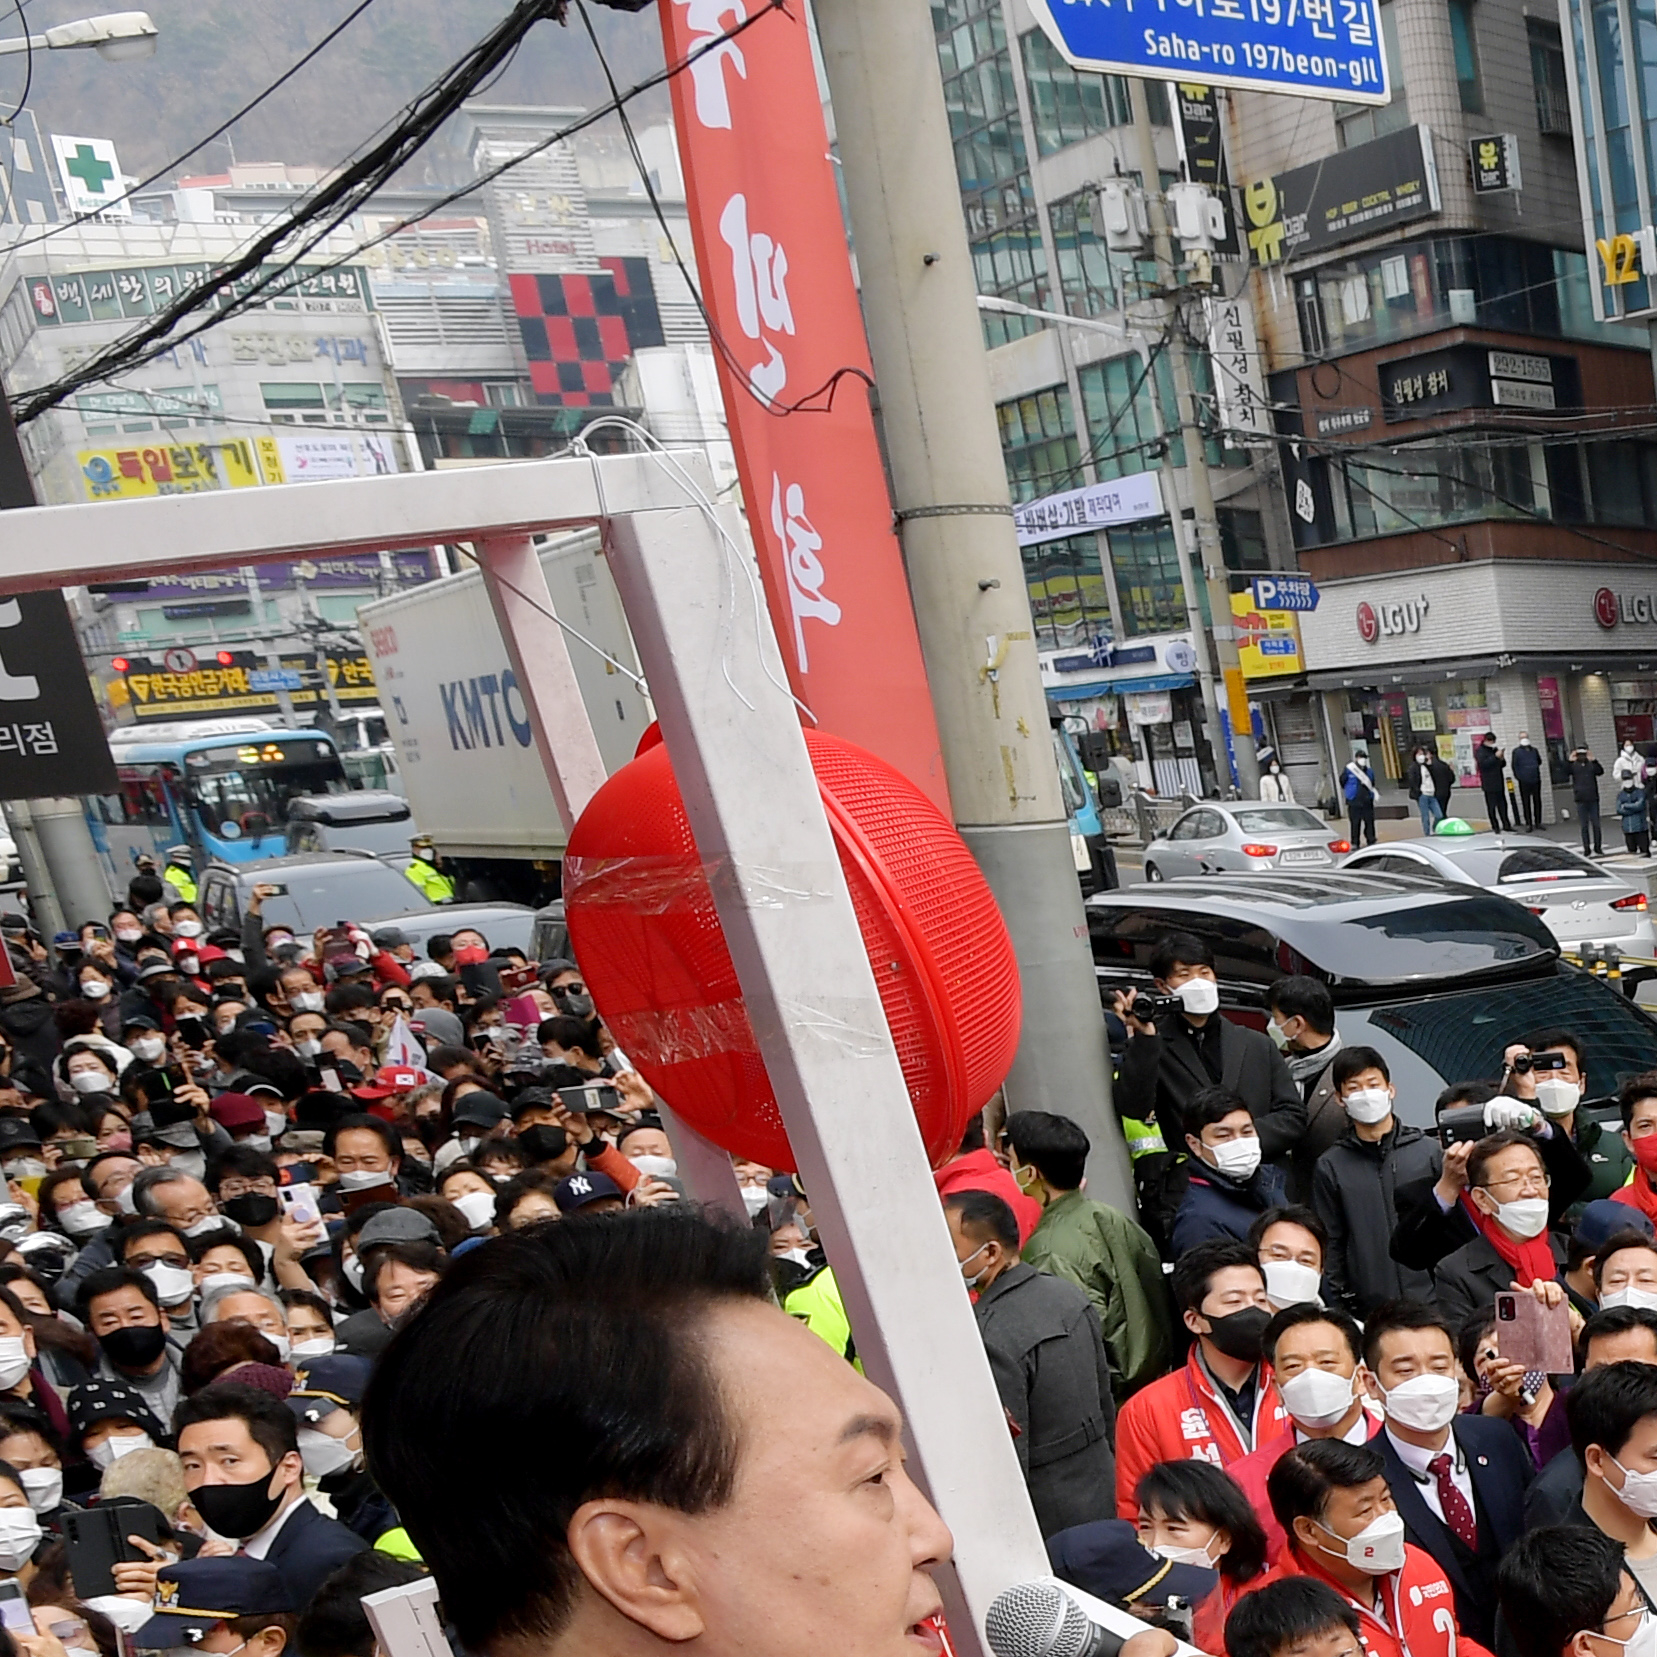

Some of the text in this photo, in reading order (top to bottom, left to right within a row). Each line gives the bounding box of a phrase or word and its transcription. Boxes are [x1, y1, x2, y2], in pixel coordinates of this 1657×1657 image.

[1144, 28, 1379, 87] Saha-ro 197beon-gil
[1283, 212, 1309, 238] bar
[1223, 305, 1250, 375] 신필성
[1392, 374, 1424, 404] 신필성
[1257, 580, 1311, 608] P 주차장
[1364, 1546, 1375, 1558] 2
